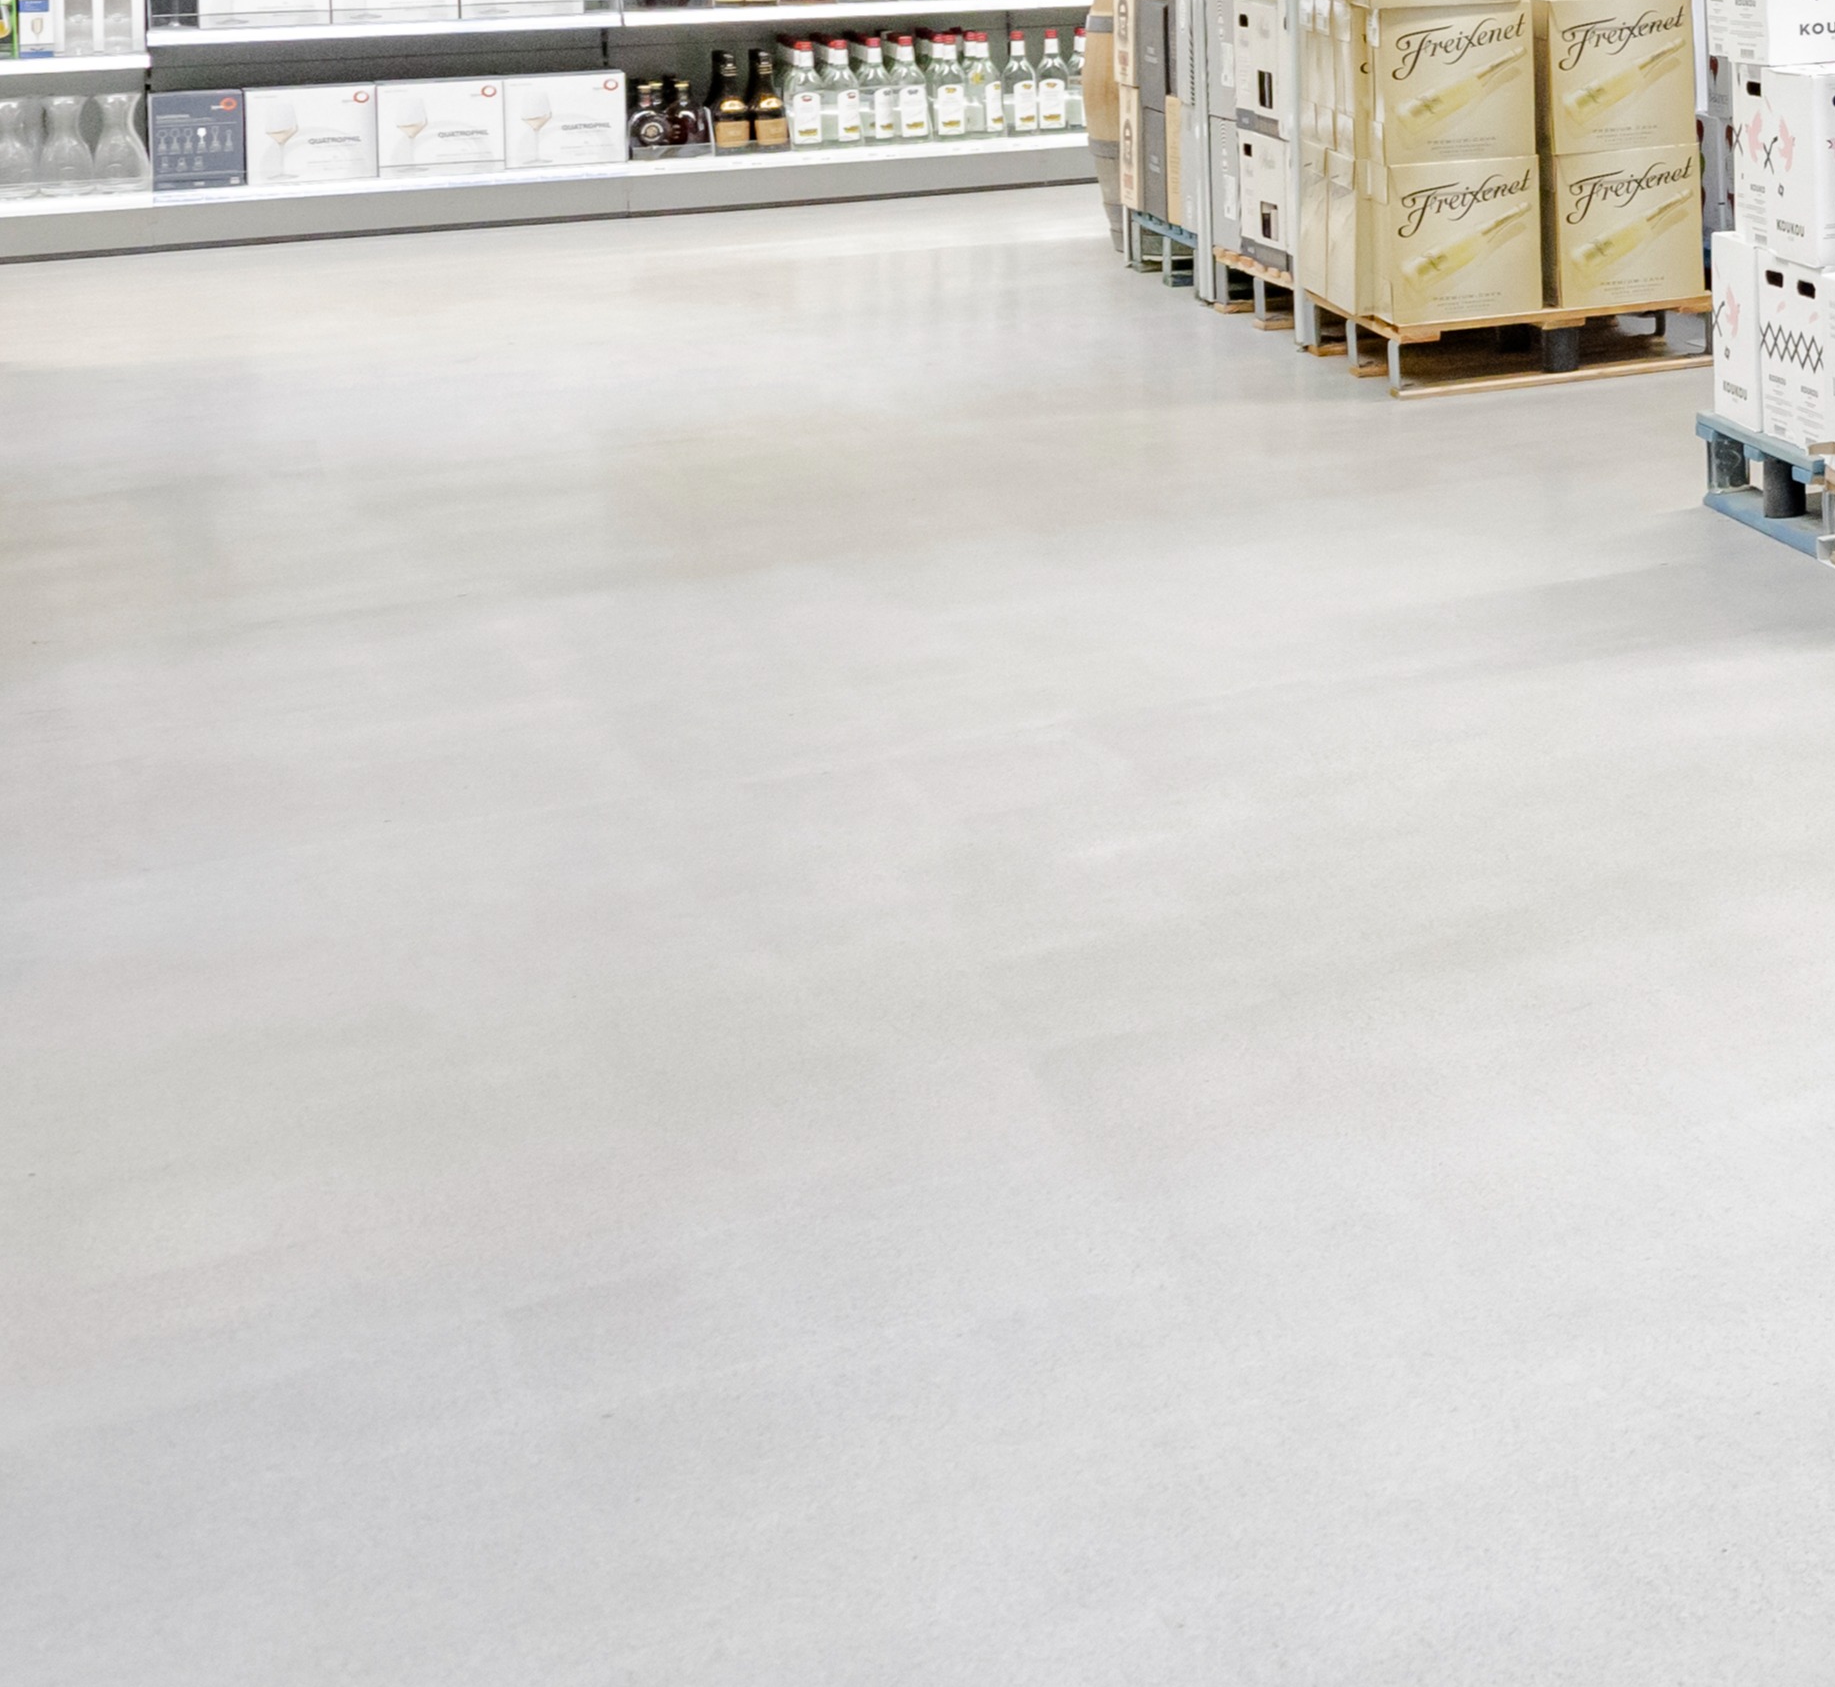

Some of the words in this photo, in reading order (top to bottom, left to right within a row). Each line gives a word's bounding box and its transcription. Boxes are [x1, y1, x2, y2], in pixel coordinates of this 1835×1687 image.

[1391, 10, 1528, 82] Freixenet
[1557, 3, 1686, 73] Freixenet
[1397, 167, 1533, 240] Freixenet
[1564, 154, 1695, 227] Freixenet
[1776, 218, 1806, 238] KOUKOU
[1722, 379, 1748, 402] KOUKOU
